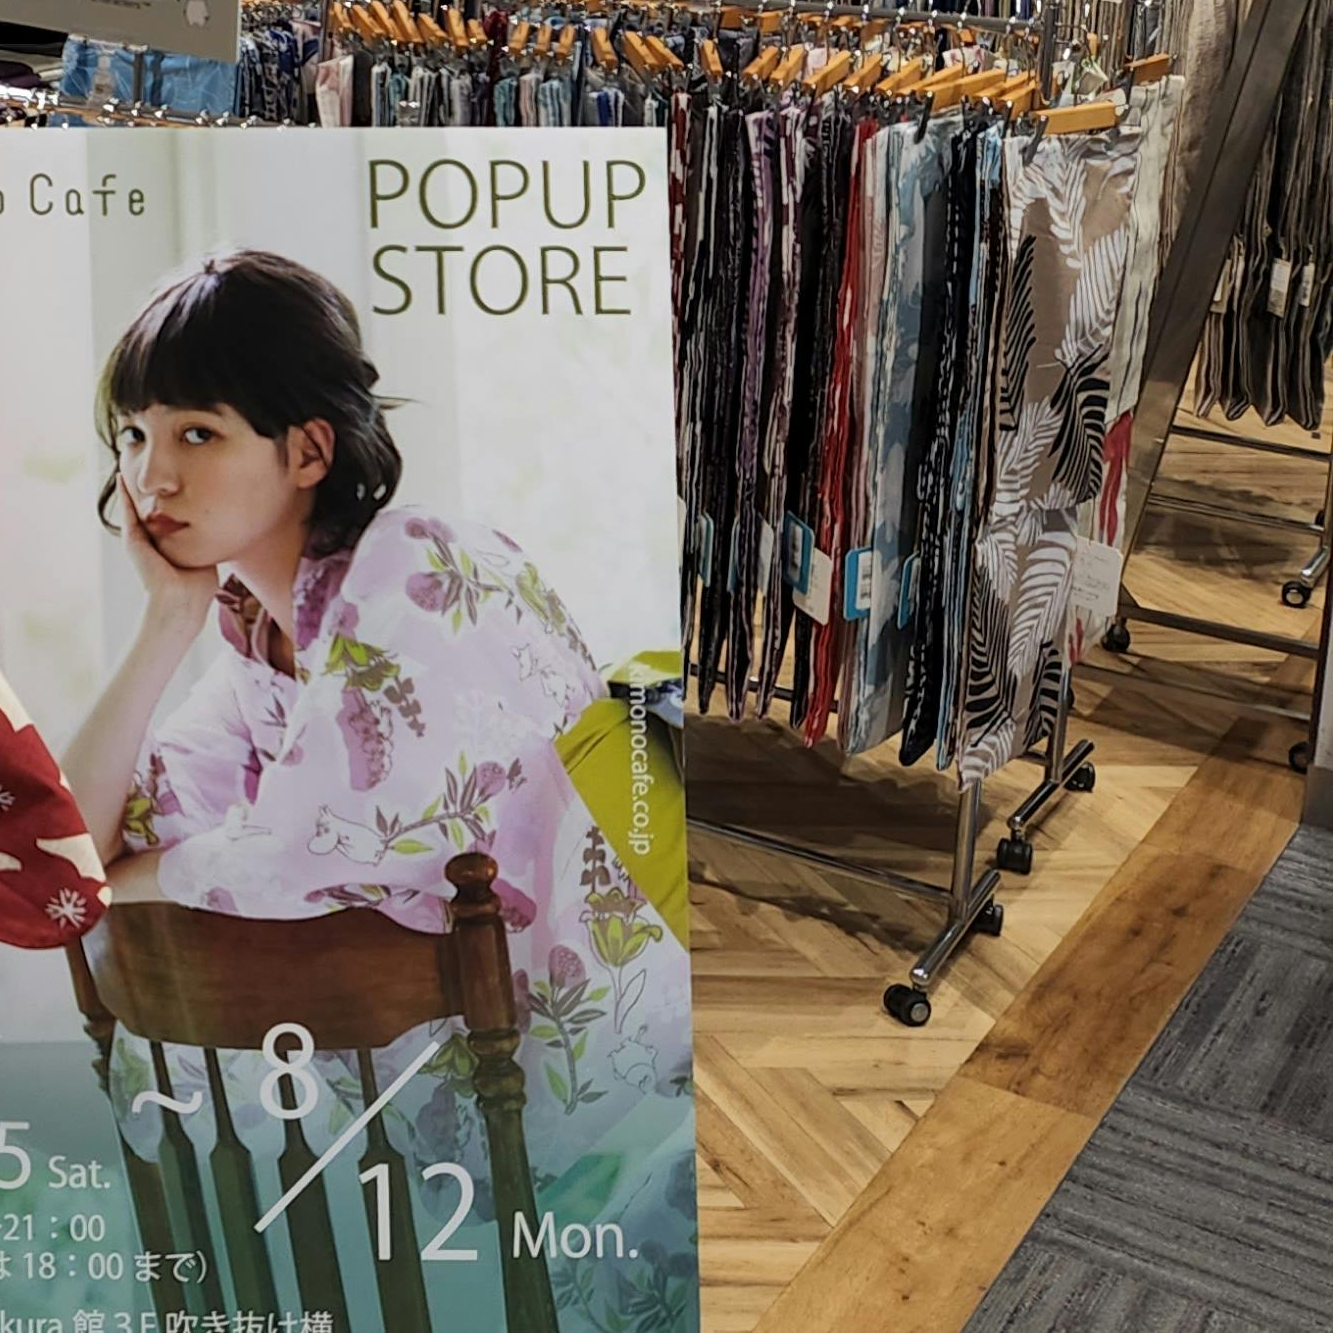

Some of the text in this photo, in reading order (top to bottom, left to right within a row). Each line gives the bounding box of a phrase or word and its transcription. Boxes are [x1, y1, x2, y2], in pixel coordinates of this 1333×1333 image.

[29, 172, 145, 216] Cafe
[369, 158, 647, 229] POPUP
[372, 243, 633, 316] STORE
[47, 1156, 111, 1189] Sat.
[512, 1211, 639, 1259] Mon.
